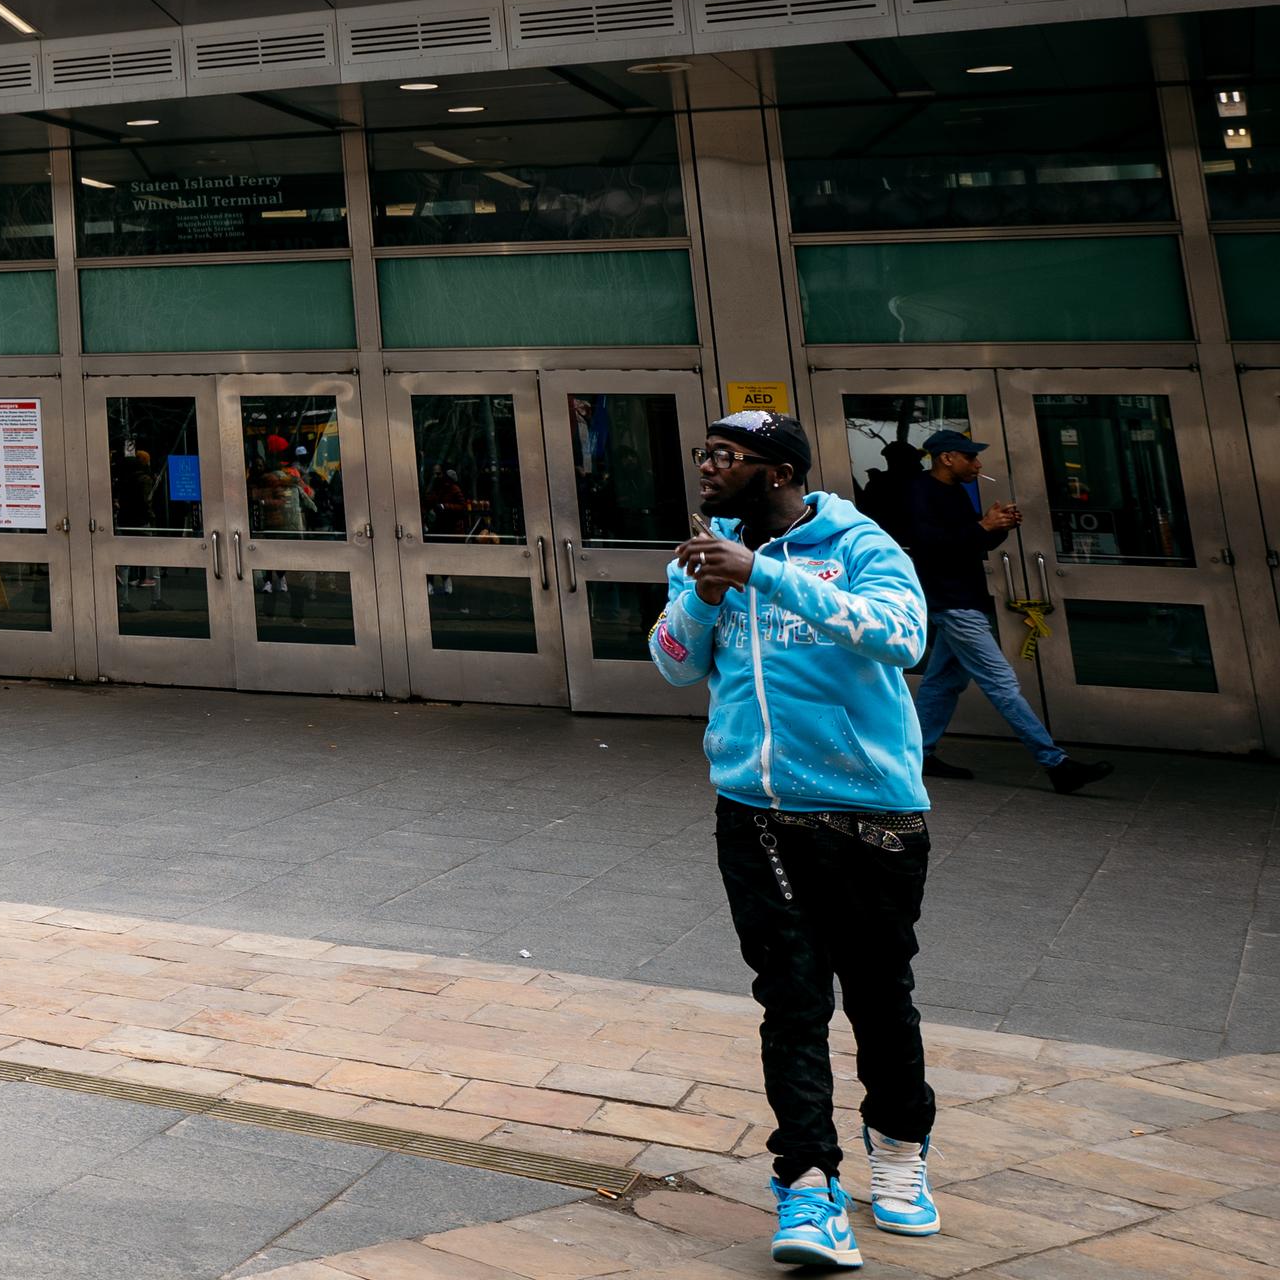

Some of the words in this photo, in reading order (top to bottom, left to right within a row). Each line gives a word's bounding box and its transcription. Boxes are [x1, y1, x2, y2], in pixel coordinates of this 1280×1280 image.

[131, 181, 179, 193] Staten
[184, 175, 235, 190] Island
[240, 175, 281, 187] Ferry
[132, 196, 208, 211] Whitehall
[211, 192, 284, 207] Terminal
[745, 394, 773, 404] AED
